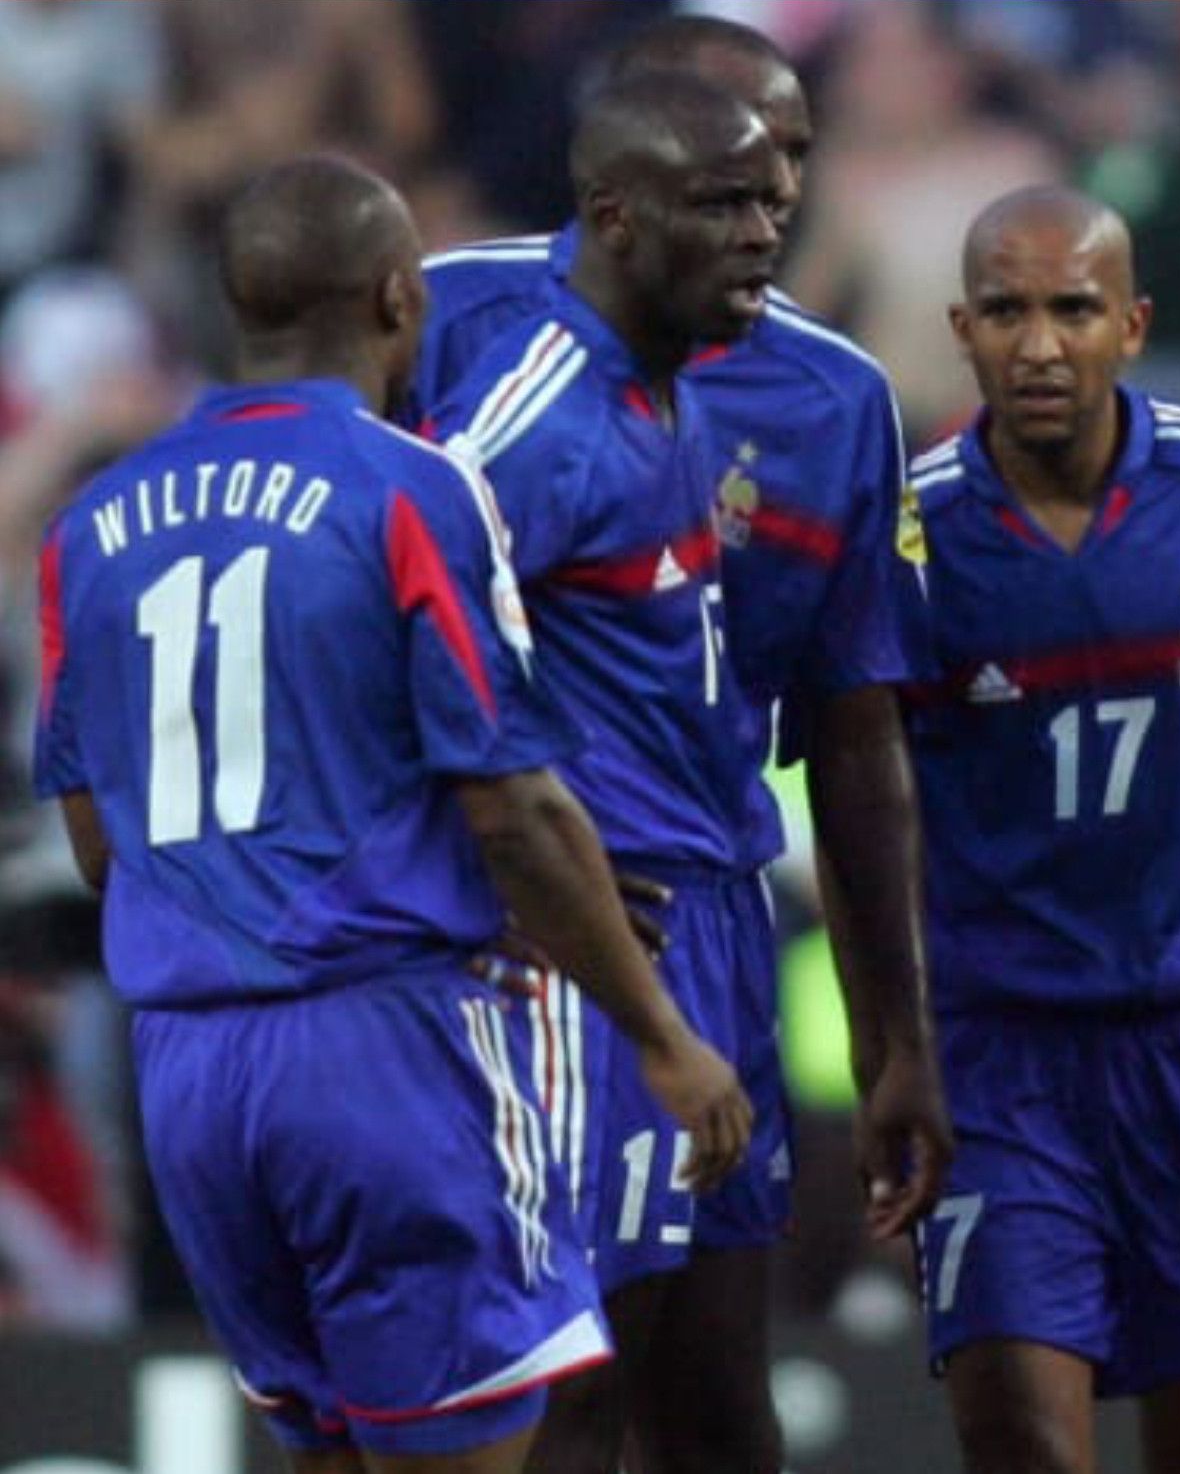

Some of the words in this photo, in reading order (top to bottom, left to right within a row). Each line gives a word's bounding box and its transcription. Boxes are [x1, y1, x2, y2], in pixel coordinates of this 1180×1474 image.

[93, 460, 332, 557] WILTORD
[137, 546, 269, 845] 11
[1049, 696, 1156, 819] 17
